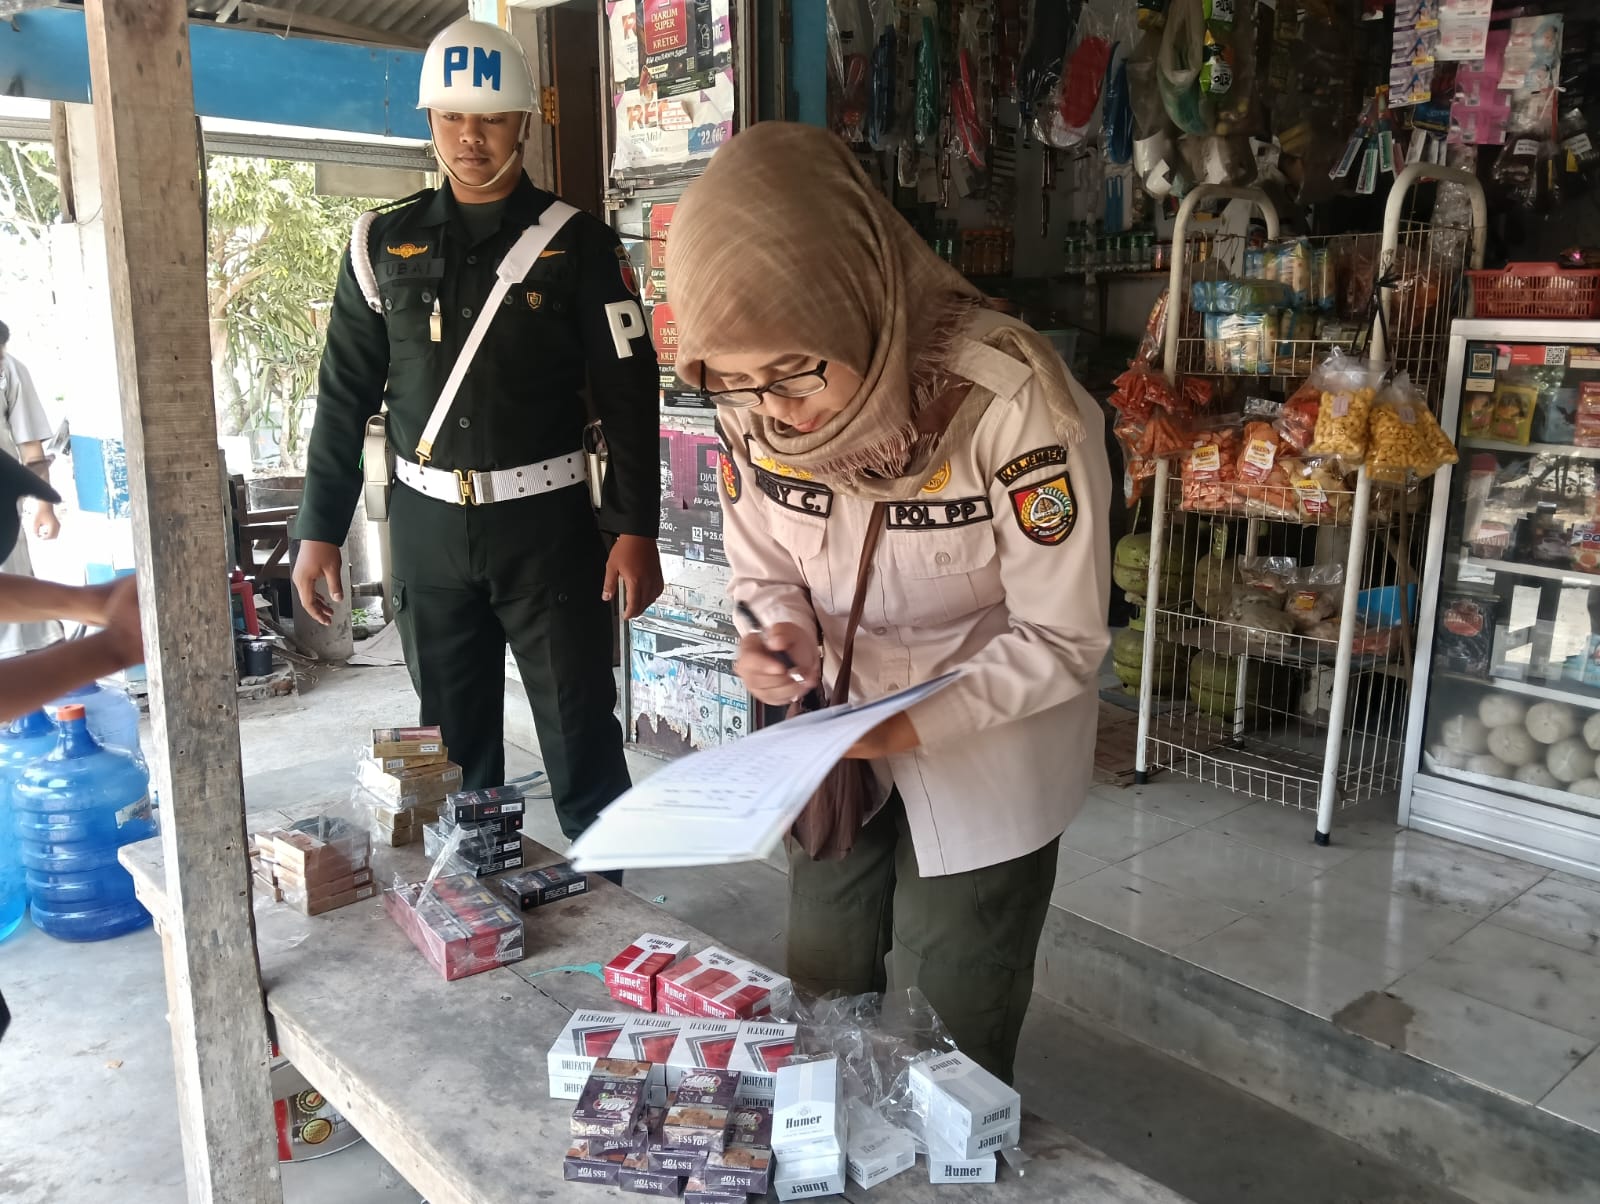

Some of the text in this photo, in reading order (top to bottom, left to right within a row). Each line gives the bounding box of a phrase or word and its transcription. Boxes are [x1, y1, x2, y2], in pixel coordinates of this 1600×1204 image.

[654, 19, 675, 31] SUPER
[653, 35, 679, 49] KRETEK
[443, 45, 501, 91] PM
[606, 302, 646, 358] P
[700, 473, 717, 482] DJAR
[800, 491, 822, 511] C.
[895, 502, 977, 526] POL PP
[614, 972, 642, 988] Humer
[664, 982, 687, 1002] Humer
[561, 1060, 592, 1072] DHIFATH
[929, 1057, 962, 1073] Humer
[742, 1076, 774, 1088] DHIFATH
[785, 1114, 822, 1129] Humer
[981, 1107, 1011, 1126] Humer
[678, 1135, 692, 1144] ESS
[677, 1162, 692, 1170] ESS
[944, 1164, 982, 1177] Humer
[592, 1170, 607, 1178] ESS
[648, 1181, 663, 1190] ESS
[736, 1177, 751, 1186] ESS
[791, 1181, 829, 1194] Humer
